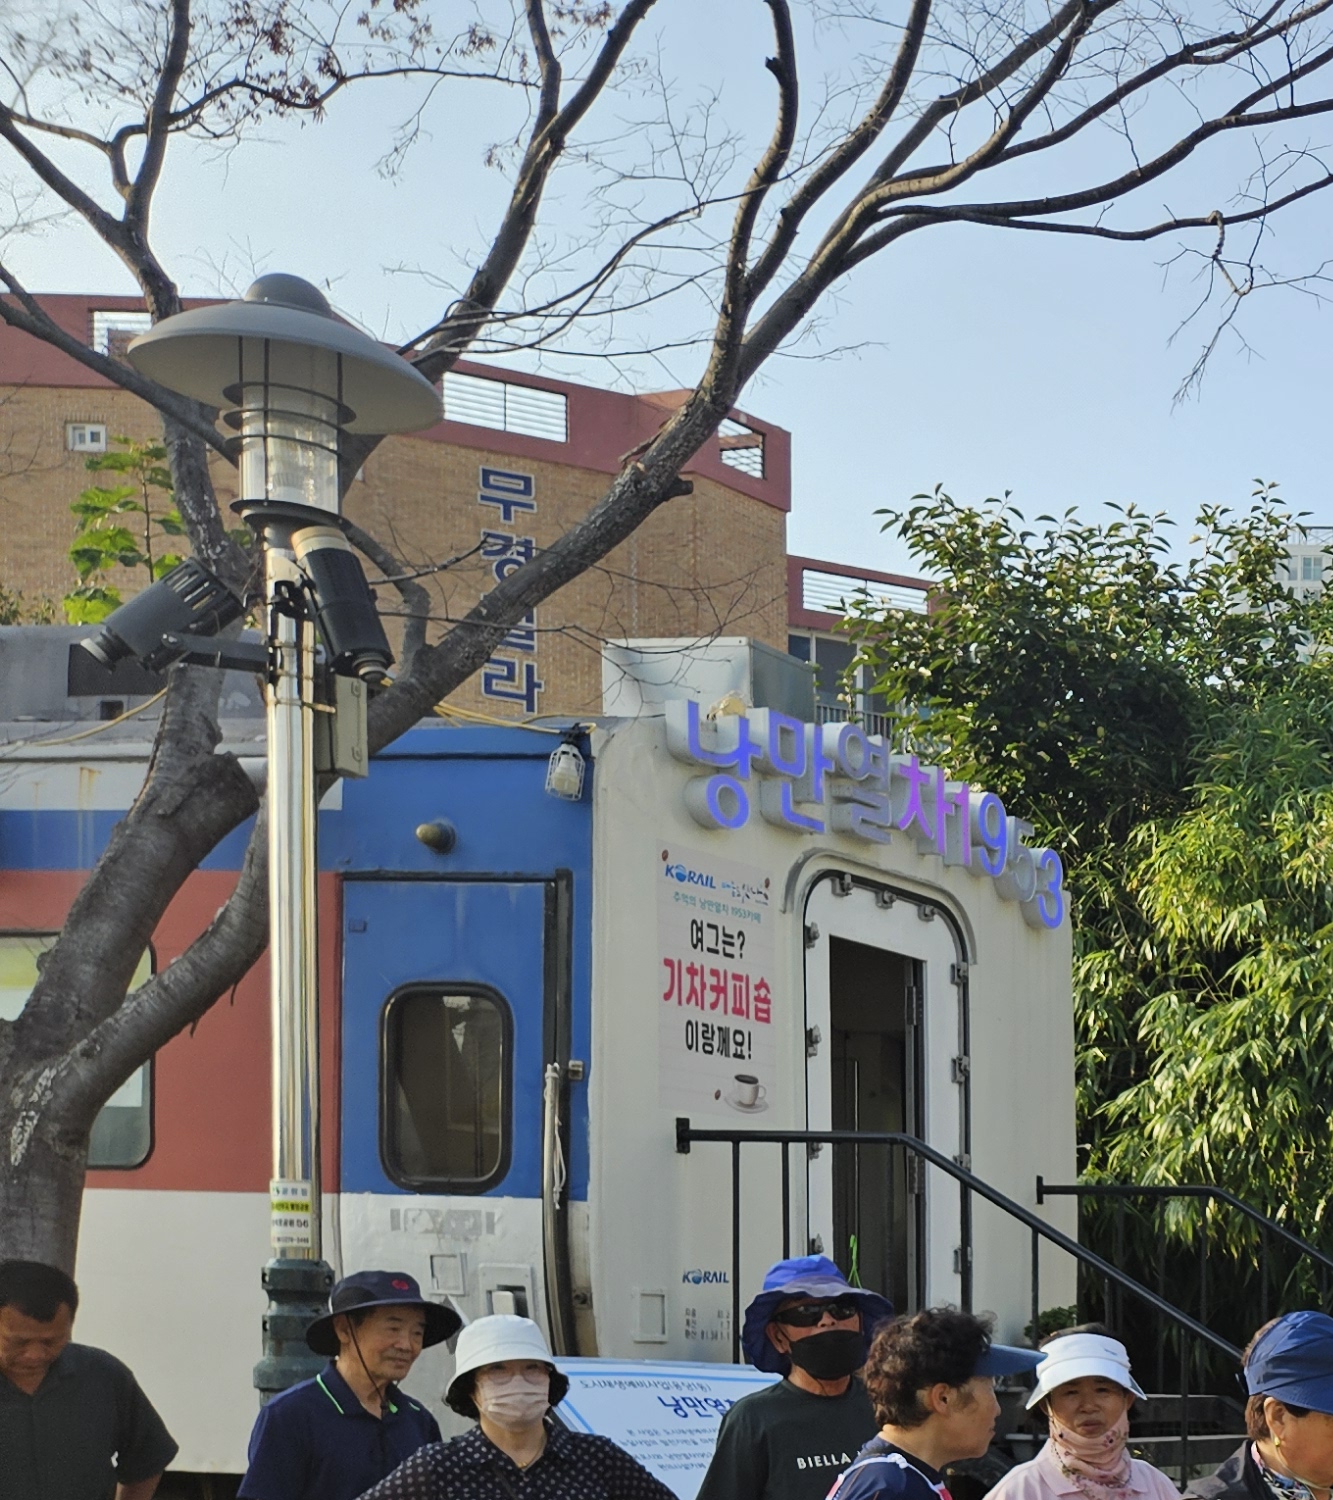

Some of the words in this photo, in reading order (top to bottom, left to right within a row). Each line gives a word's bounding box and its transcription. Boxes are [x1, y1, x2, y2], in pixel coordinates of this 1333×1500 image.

[479, 466, 544, 714] 무정라
[665, 864, 716, 889] KORAIL
[690, 919, 746, 959] 여그는?
[663, 958, 772, 1024] 기차커피숍
[685, 1019, 752, 1061] 이랑께요!
[682, 1268, 729, 1285] KORAIL
[797, 1452, 851, 1469] BIELLA
